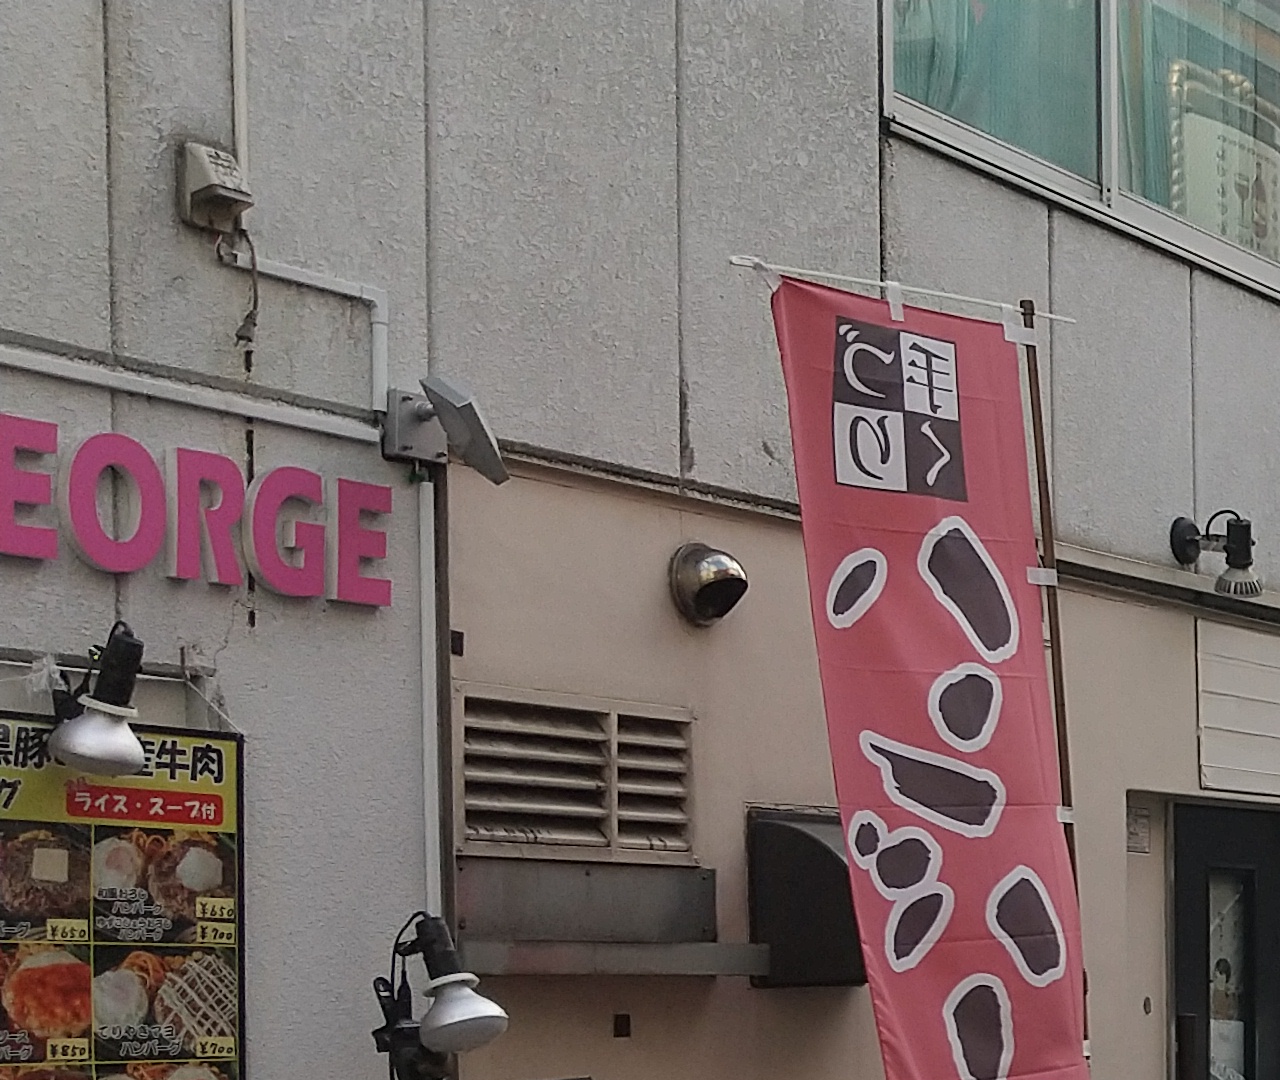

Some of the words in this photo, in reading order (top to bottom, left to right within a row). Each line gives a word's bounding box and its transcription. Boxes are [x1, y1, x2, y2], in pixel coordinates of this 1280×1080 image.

[0, 413, 393, 608] EORGE
[199, 901, 235, 918] ¥650
[49, 925, 87, 940] ¥650
[199, 925, 234, 940] ¥700
[49, 1043, 87, 1058] ¥850
[119, 1039, 184, 1057] ハンバーグ
[199, 1041, 235, 1056] ¥700
